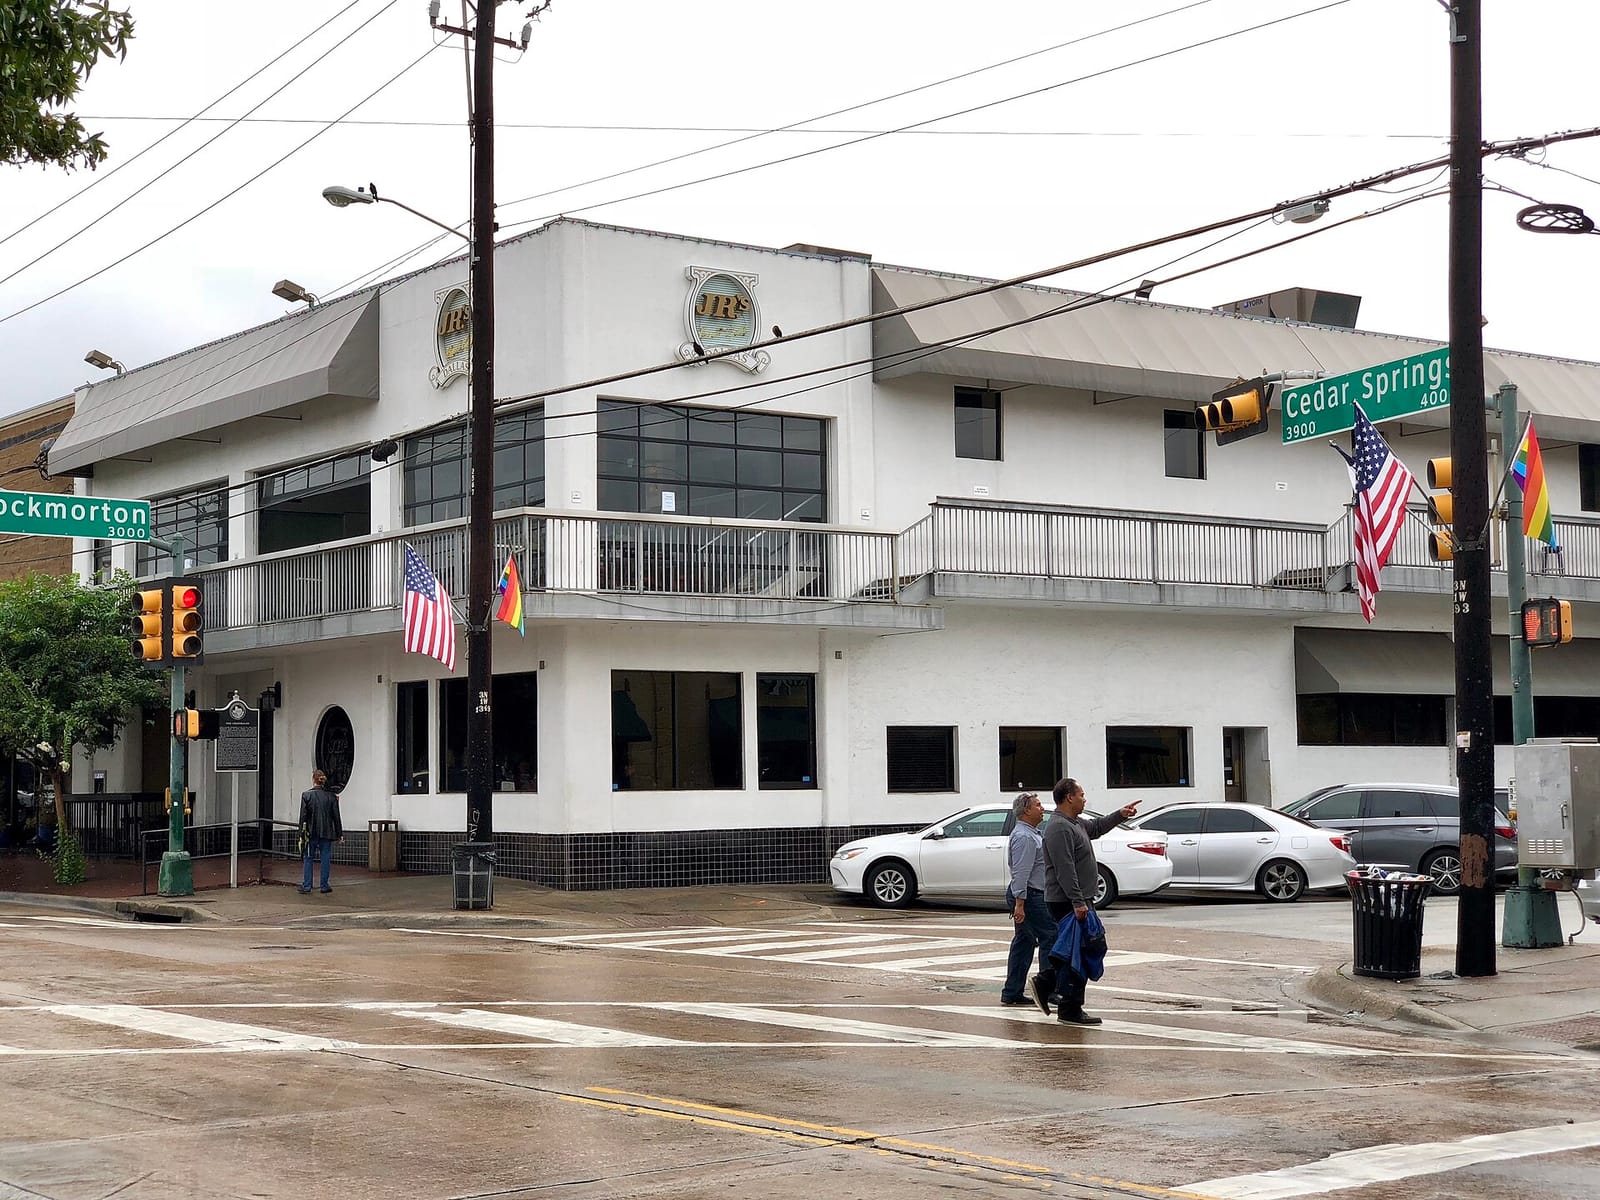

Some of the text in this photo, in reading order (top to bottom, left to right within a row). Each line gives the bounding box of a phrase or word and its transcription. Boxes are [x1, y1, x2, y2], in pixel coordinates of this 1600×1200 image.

[695, 293, 752, 319] JR's
[438, 304, 471, 336] JR's
[1286, 381, 1350, 418] Cedar
[1286, 421, 1316, 440] 3900
[107, 526, 146, 539] 3000
[1453, 580, 1467, 591] 3N
